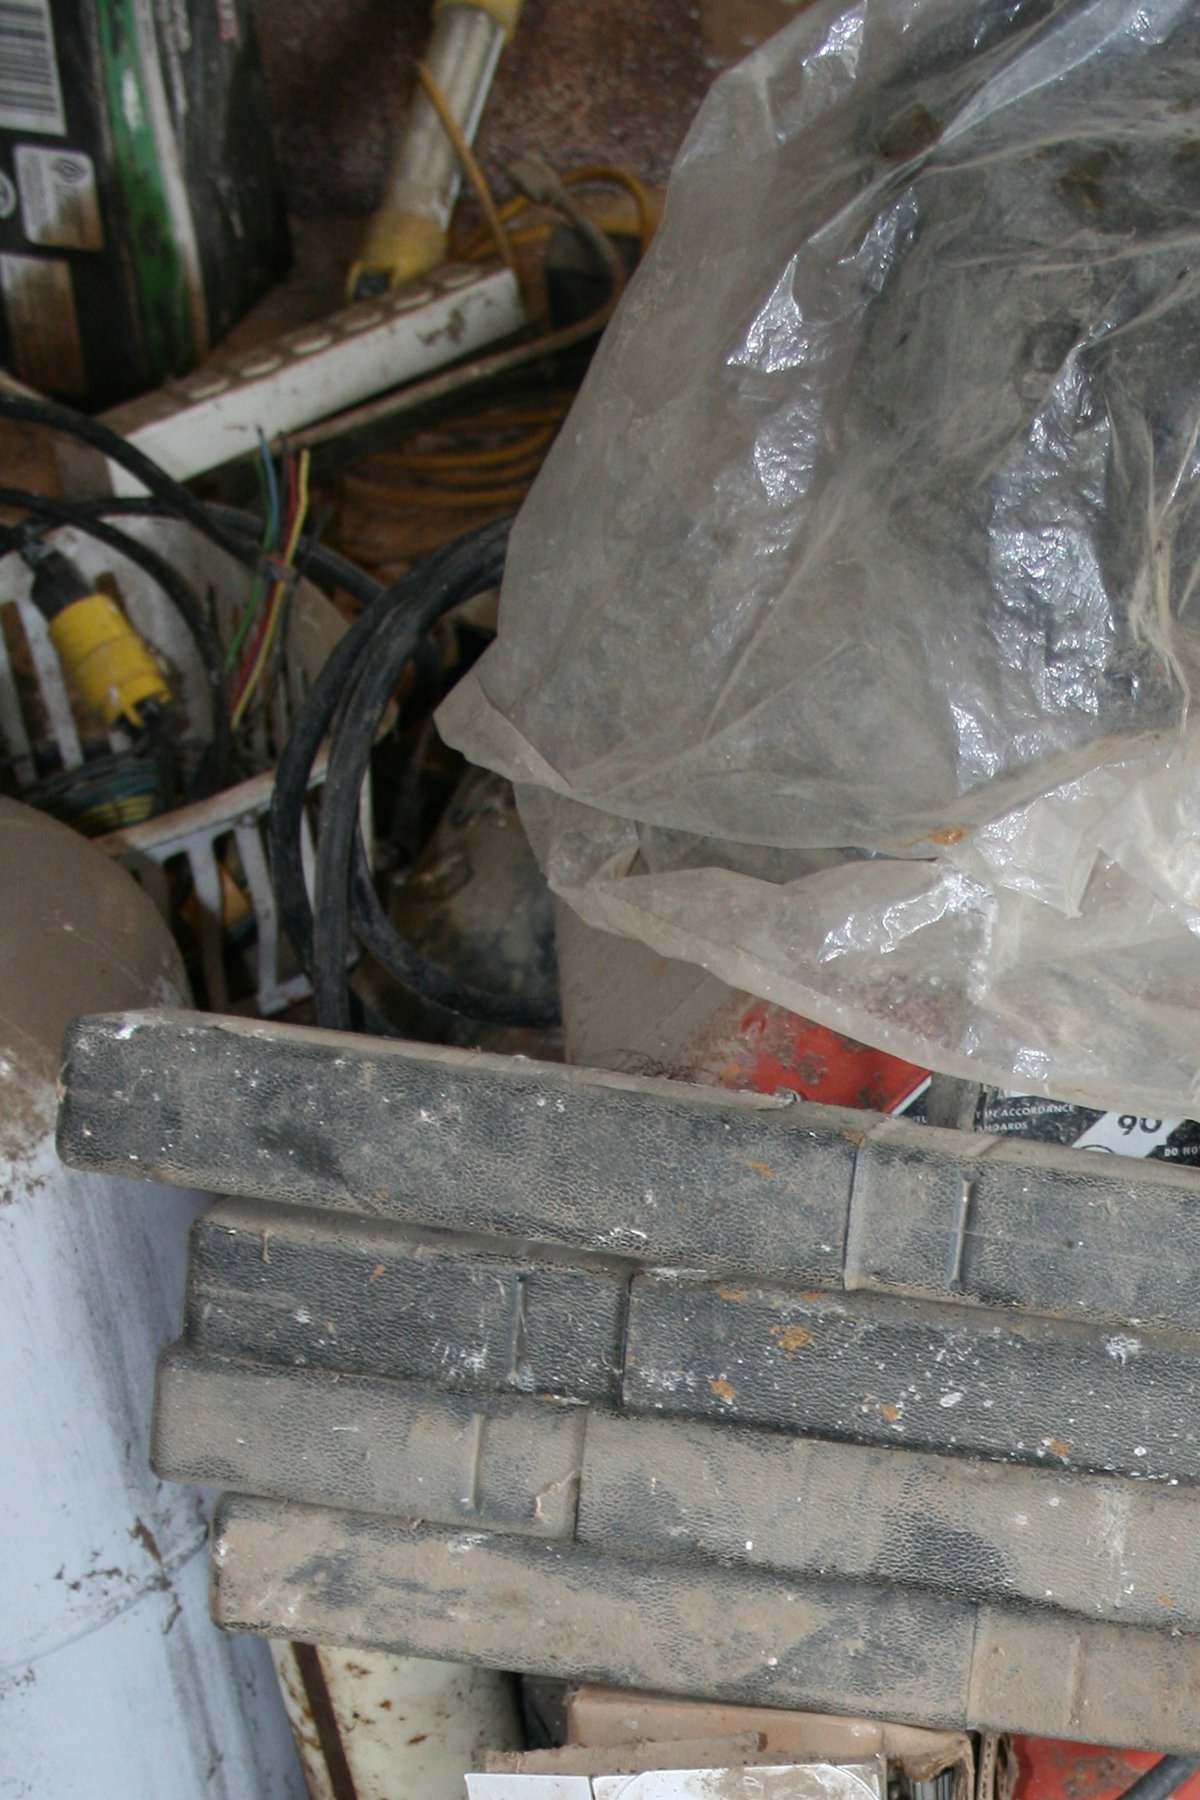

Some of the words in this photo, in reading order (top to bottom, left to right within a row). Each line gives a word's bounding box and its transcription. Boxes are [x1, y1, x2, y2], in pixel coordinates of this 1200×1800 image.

[1000, 1103, 1075, 1118] ACCORDANCE
[1117, 1114, 1163, 1136] 90
[1164, 1148, 1179, 1157] DO
